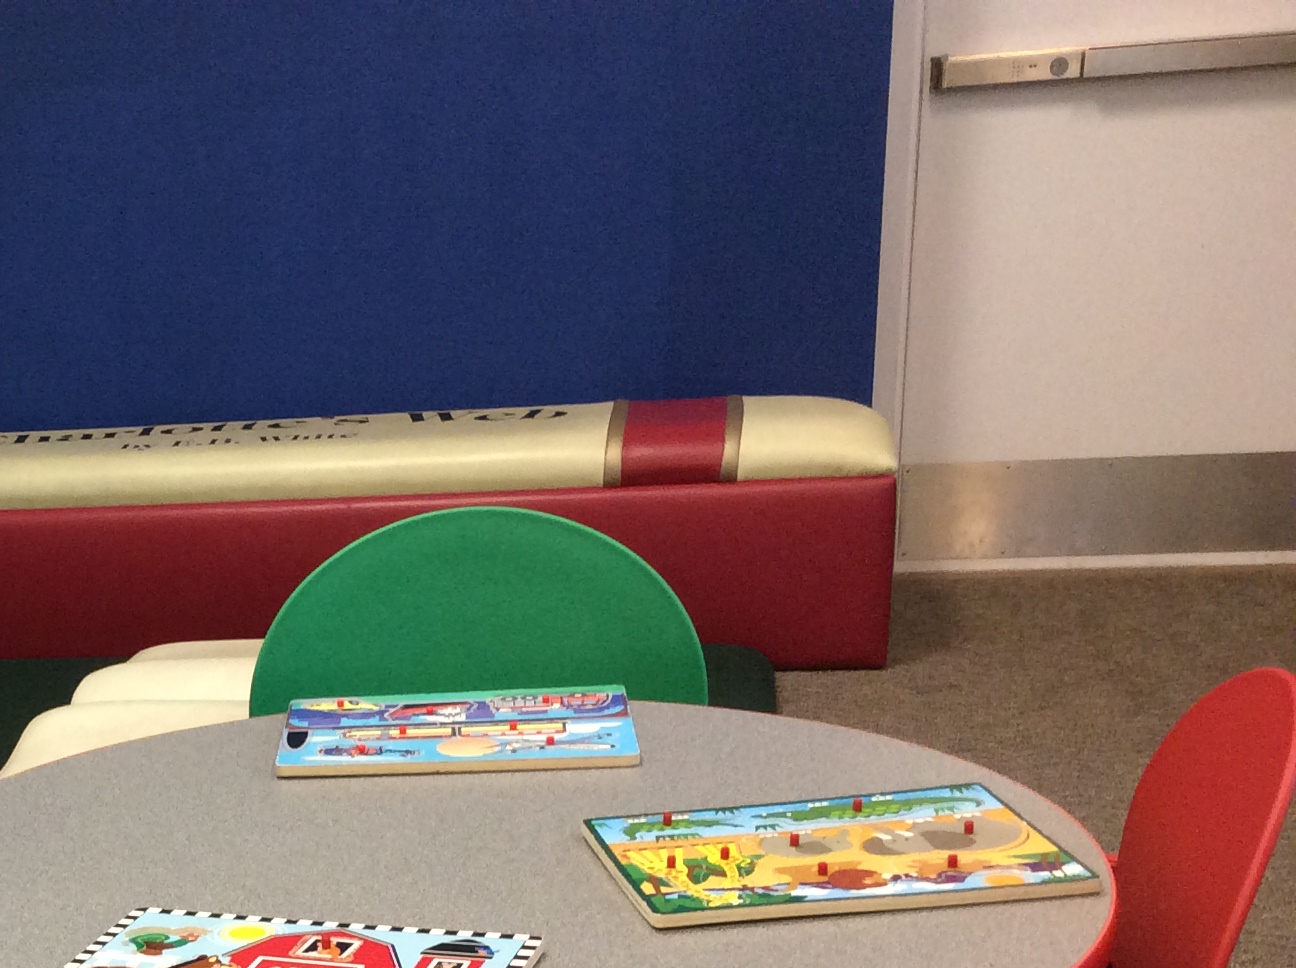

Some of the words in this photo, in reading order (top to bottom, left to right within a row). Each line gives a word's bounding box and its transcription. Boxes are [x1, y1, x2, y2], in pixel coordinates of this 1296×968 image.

[407, 408, 569, 423] Web
[120, 443, 157, 451] by
[260, 433, 359, 442] White
